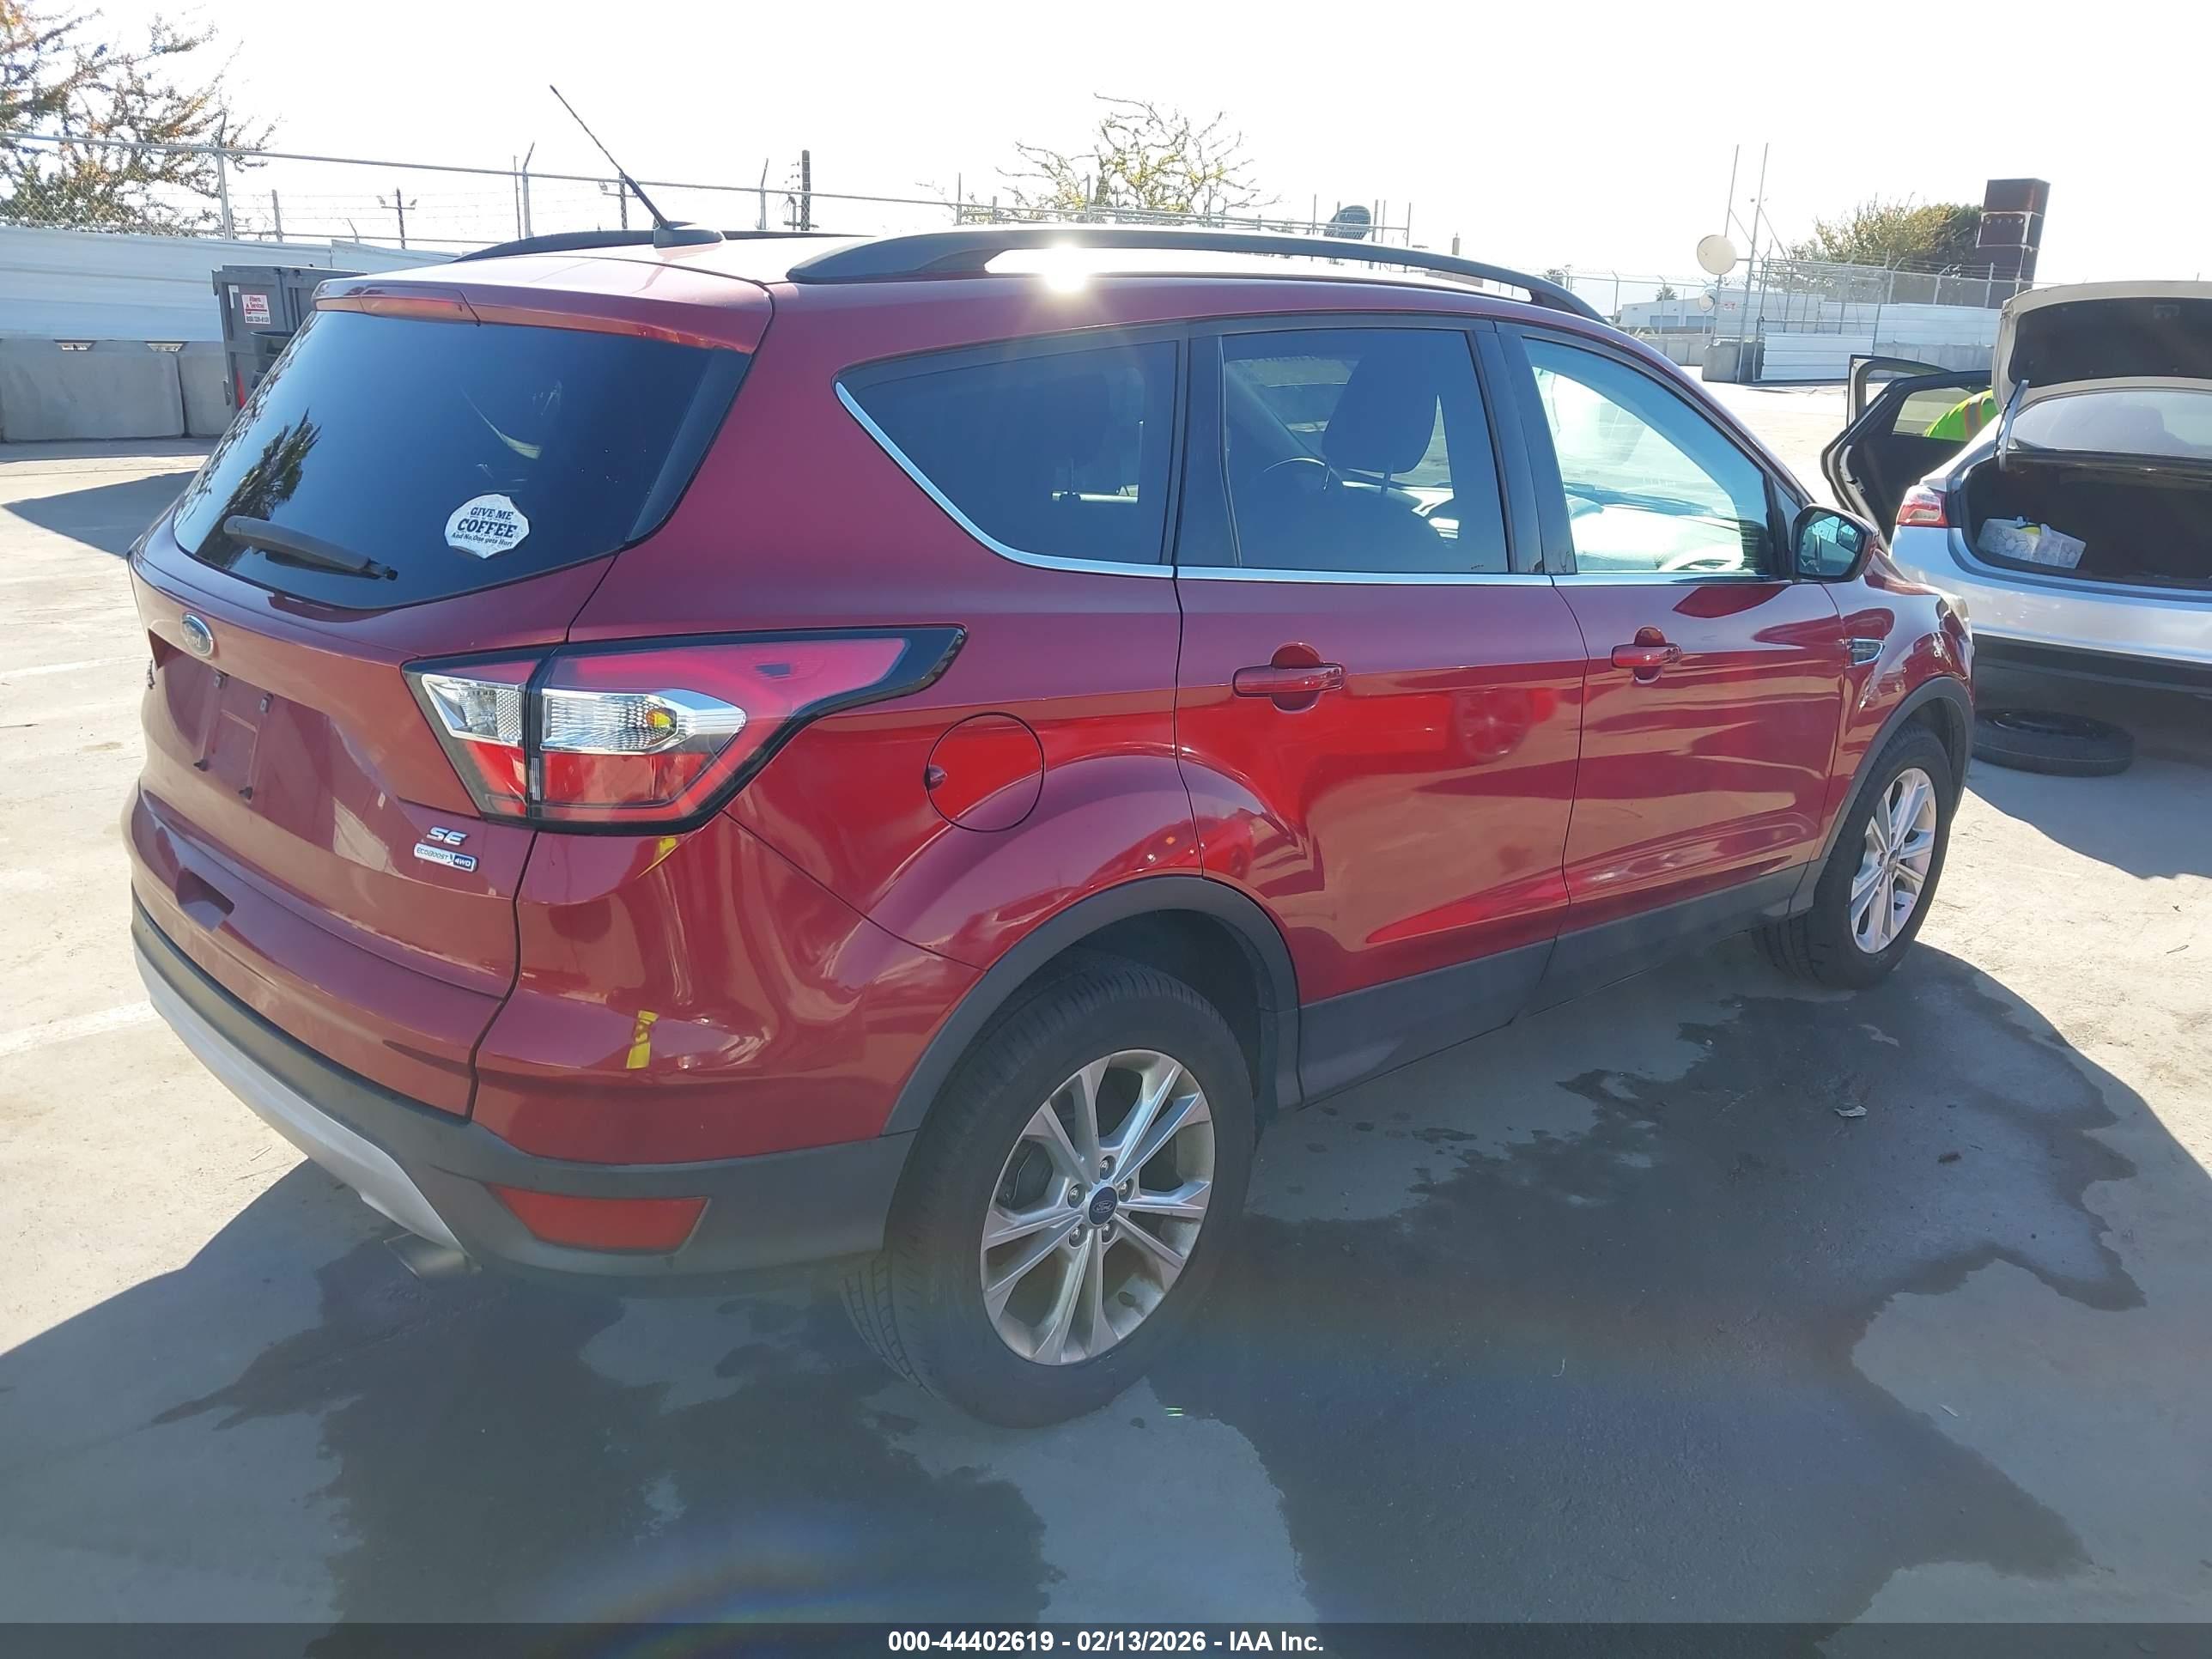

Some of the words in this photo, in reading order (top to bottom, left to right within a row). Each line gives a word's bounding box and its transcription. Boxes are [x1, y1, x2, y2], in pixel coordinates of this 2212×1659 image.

[470, 507, 495, 518] GIVE
[495, 510, 514, 520] ME
[457, 518, 518, 538] COFFEE
[426, 826, 468, 846] SE
[416, 847, 449, 860] ECOBOOST
[454, 858, 471, 867] 4WD
